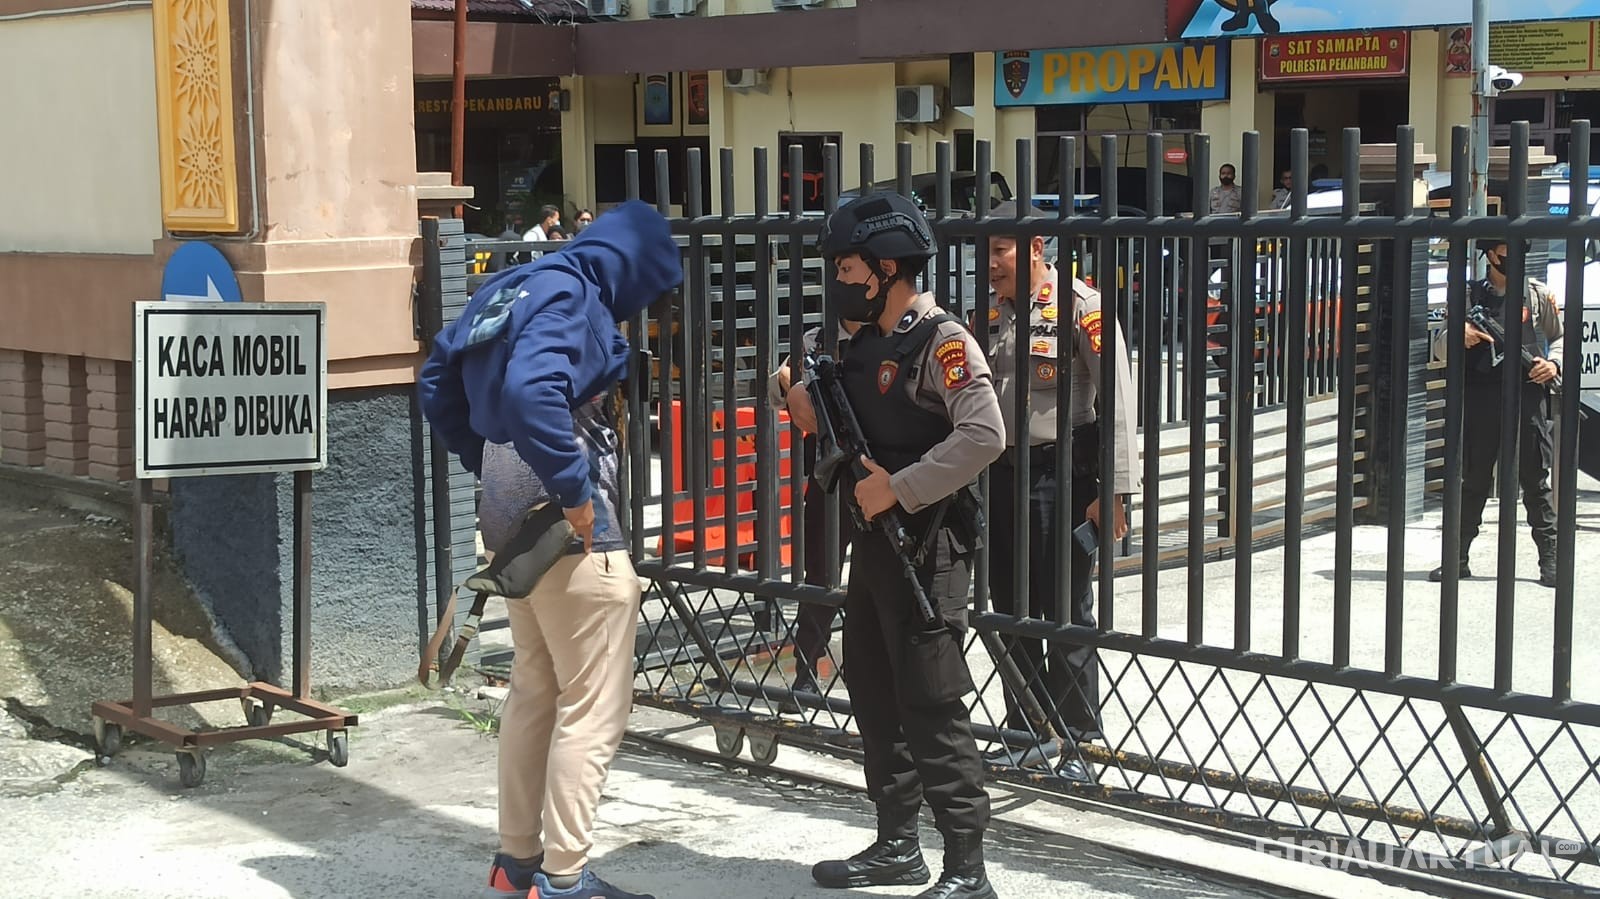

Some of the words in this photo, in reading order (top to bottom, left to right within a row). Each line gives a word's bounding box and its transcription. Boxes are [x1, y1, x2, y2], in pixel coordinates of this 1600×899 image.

[1288, 40, 1312, 55] SAT
[1317, 36, 1380, 53] SAMAPTA
[1043, 45, 1215, 94] PROPAM
[1280, 58, 1327, 73] POLRESTA
[1329, 56, 1387, 71] PEKANBARU
[415, 99, 453, 112] REST
[158, 335, 225, 377] KACA
[233, 335, 306, 376] MOBIL
[154, 396, 226, 439] HARAP
[234, 394, 313, 436] DIBUKA
